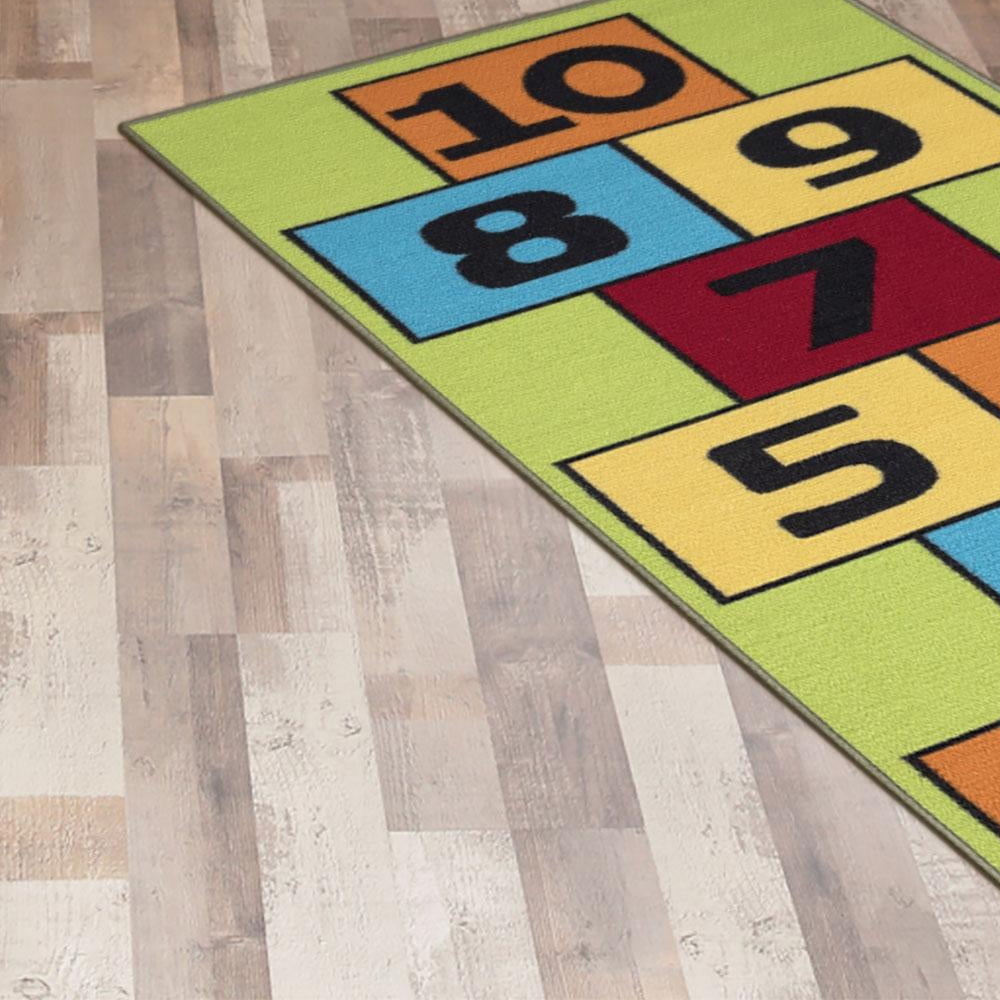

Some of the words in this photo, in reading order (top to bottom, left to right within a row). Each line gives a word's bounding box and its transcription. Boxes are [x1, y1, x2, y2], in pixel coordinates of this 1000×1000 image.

[387, 45, 686, 160] 10
[739, 106, 922, 188] 9
[421, 191, 629, 288] 8
[710, 236, 878, 349] 7
[708, 404, 938, 539] 5
